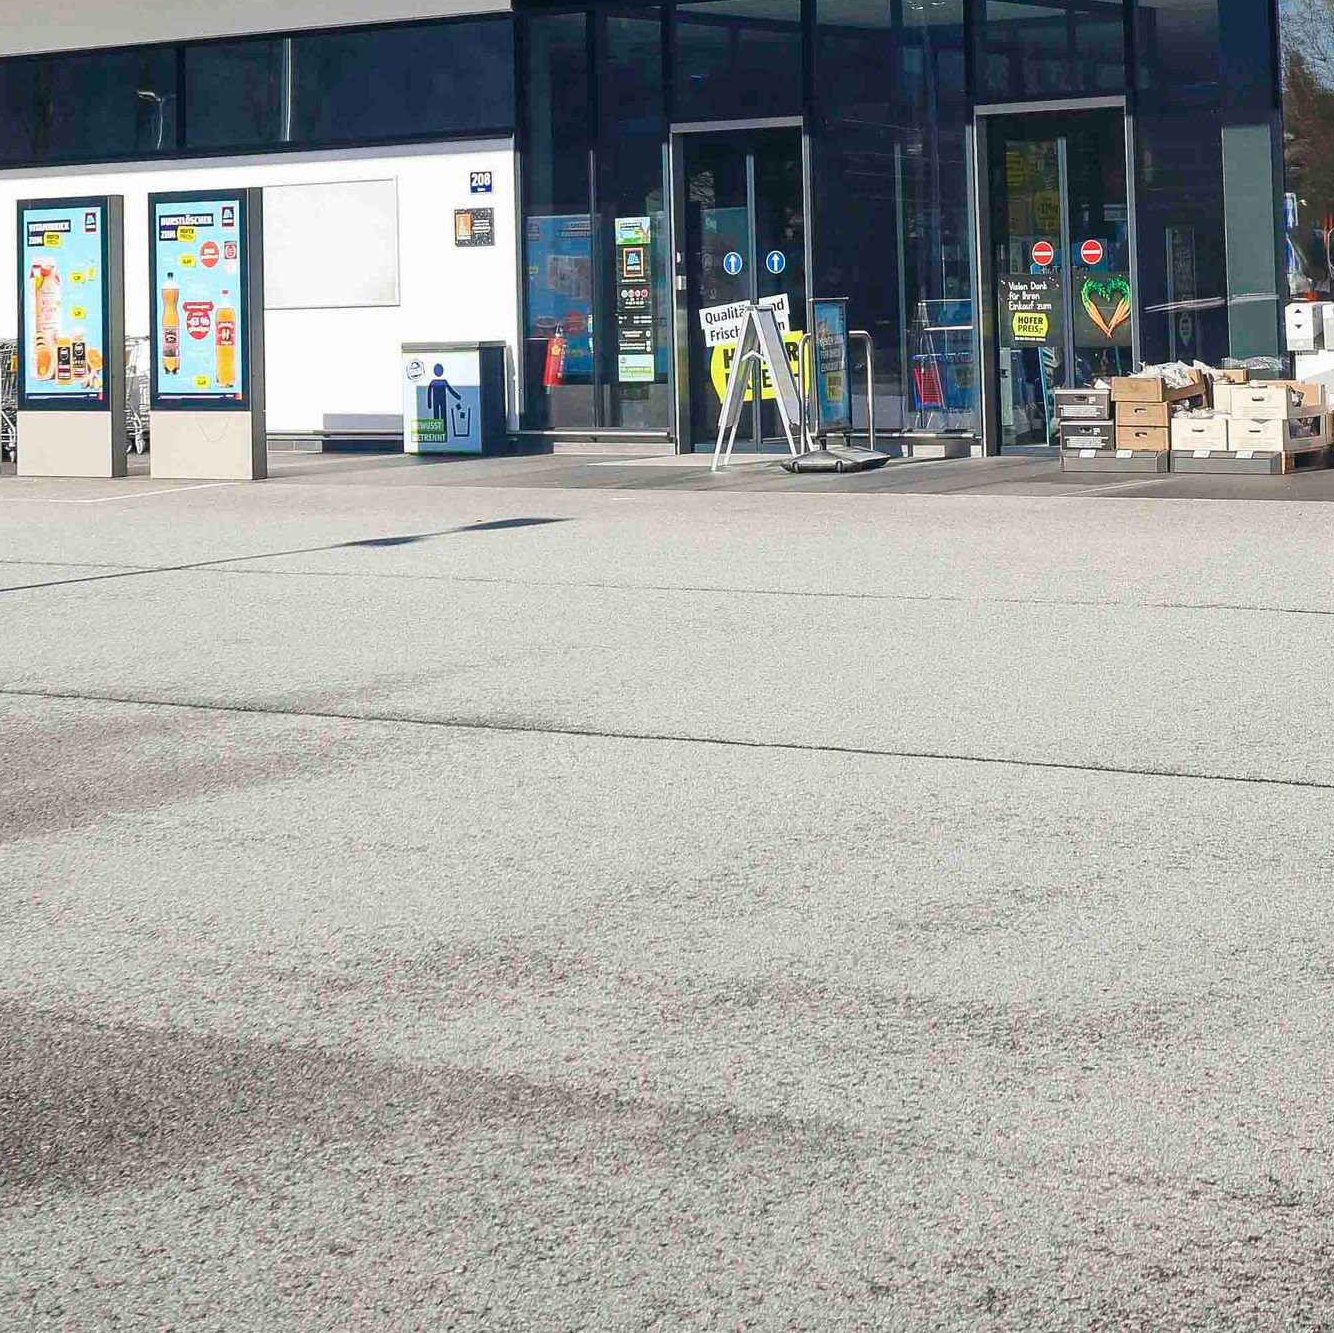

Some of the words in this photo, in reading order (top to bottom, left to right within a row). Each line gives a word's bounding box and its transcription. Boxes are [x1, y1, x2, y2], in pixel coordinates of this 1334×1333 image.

[471, 172, 491, 187] 208
[1008, 282, 1028, 291] Vielen
[1030, 281, 1048, 291] Dank
[1008, 291, 1020, 301] für
[1008, 300, 1034, 311] Einkauf
[1036, 302, 1052, 310] zum
[705, 304, 748, 324] Qualitä
[1017, 316, 1043, 325] HOFER
[710, 325, 740, 342] Frisch
